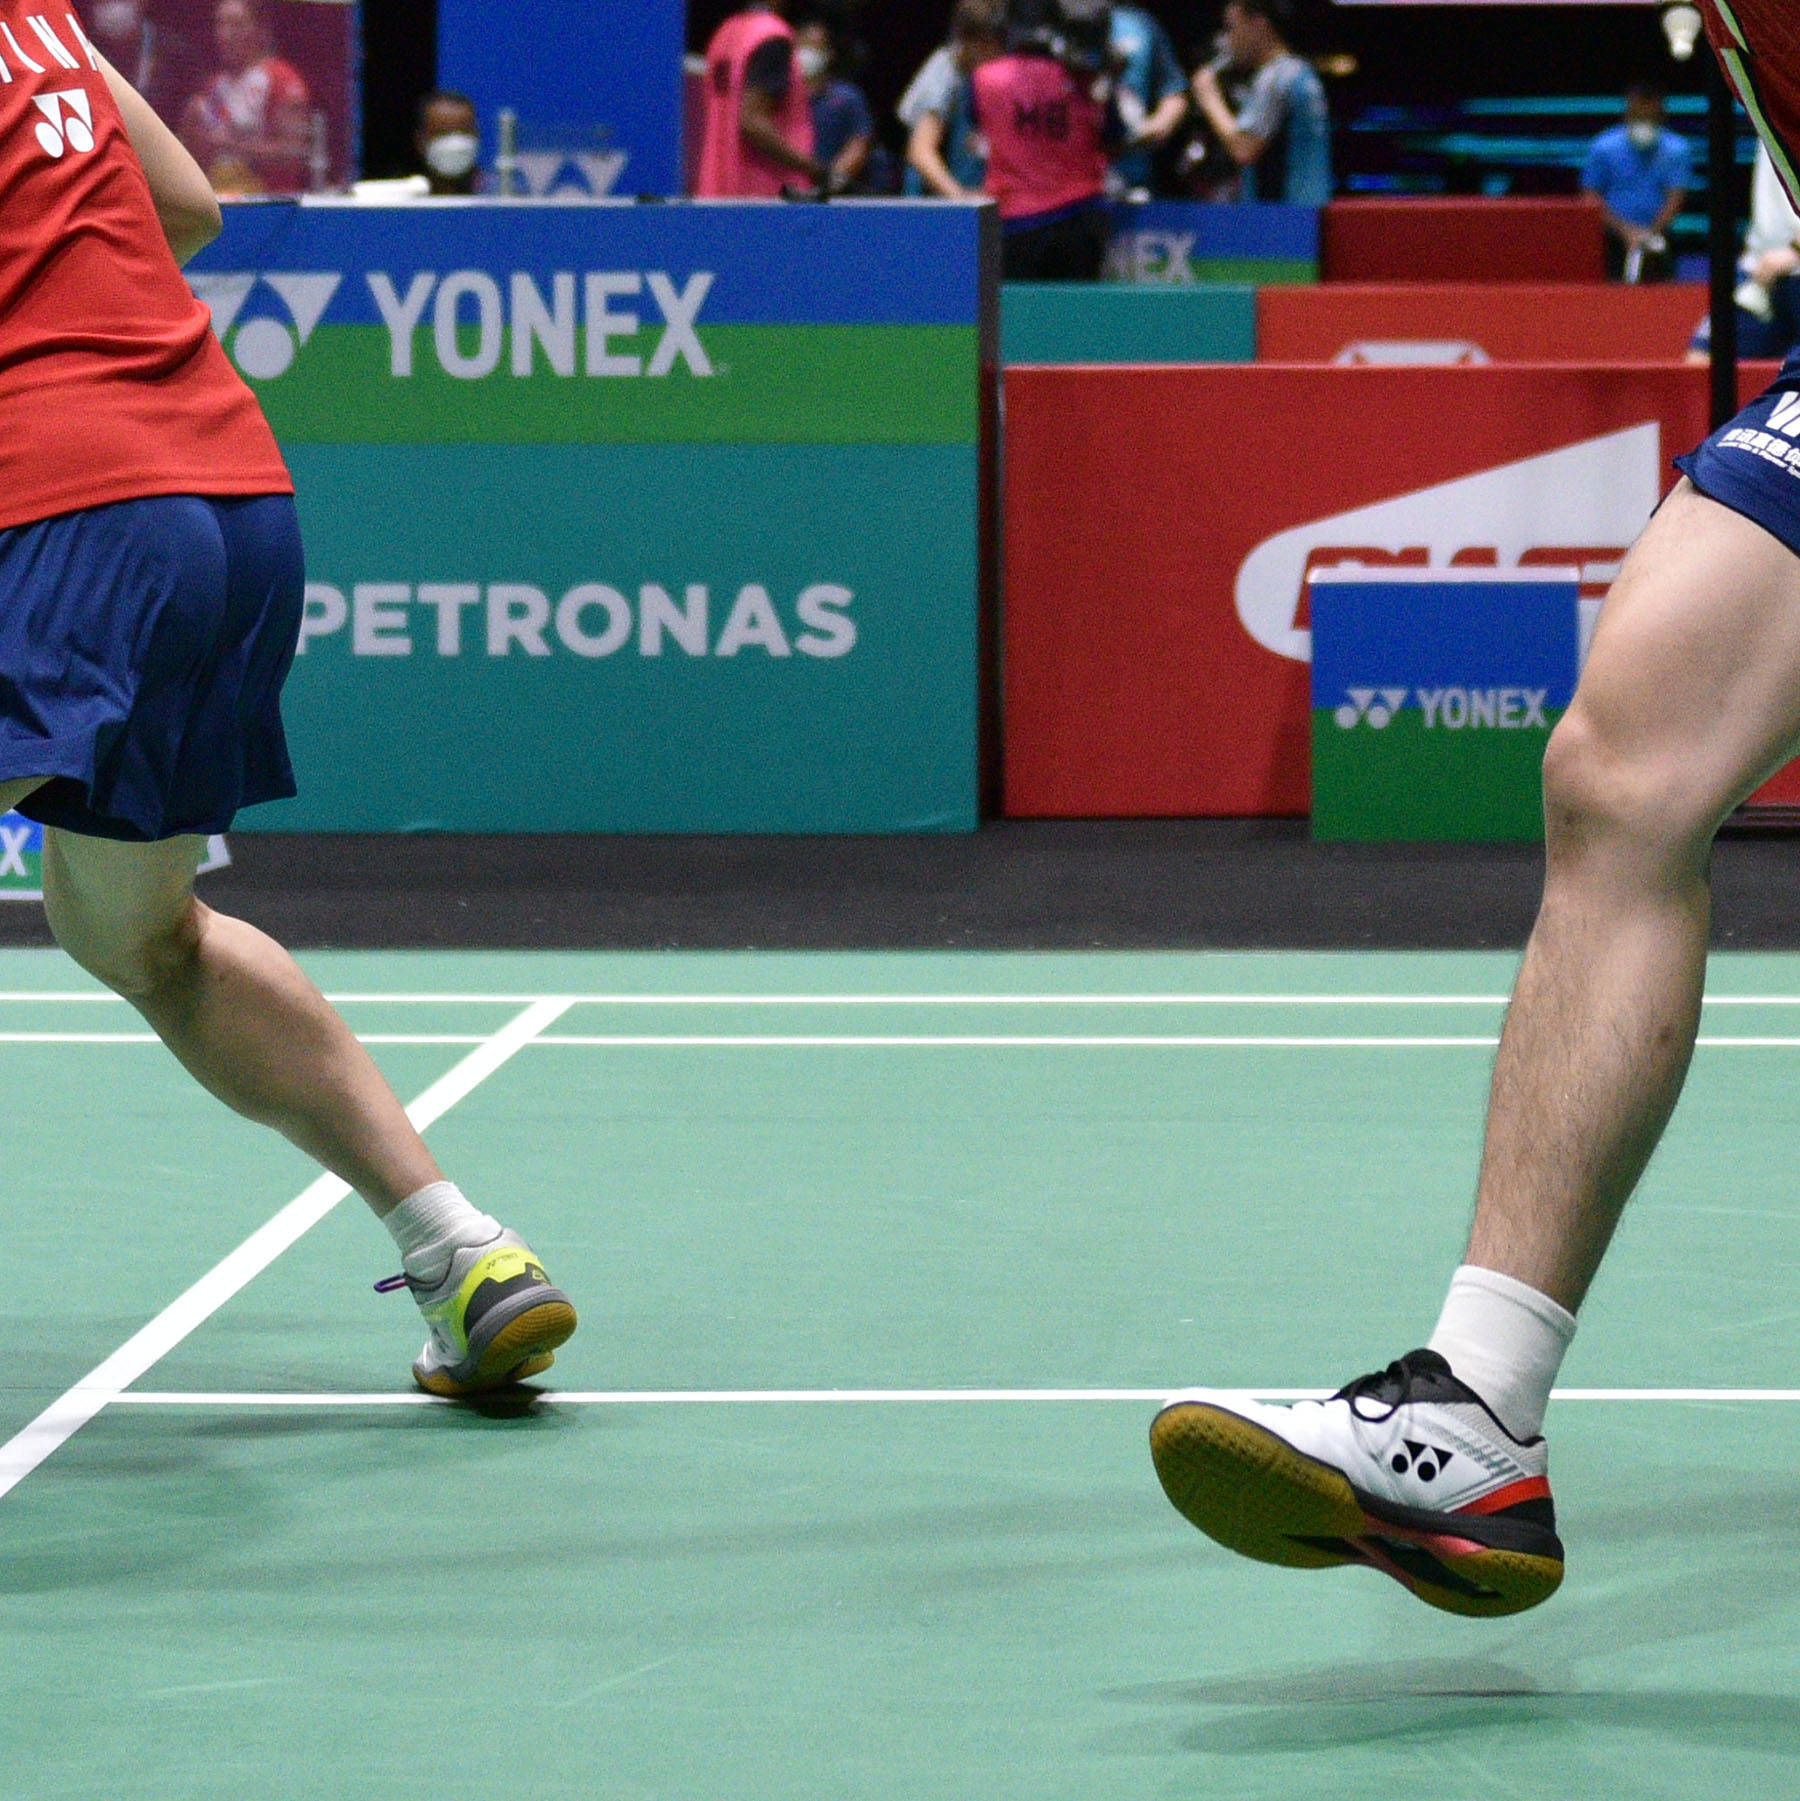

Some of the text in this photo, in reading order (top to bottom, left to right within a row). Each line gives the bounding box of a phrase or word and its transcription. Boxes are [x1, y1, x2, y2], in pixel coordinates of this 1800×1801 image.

[364, 272, 716, 379] YONEX
[299, 582, 857, 658] PETRONAS
[1417, 689, 1548, 729] YONEX
